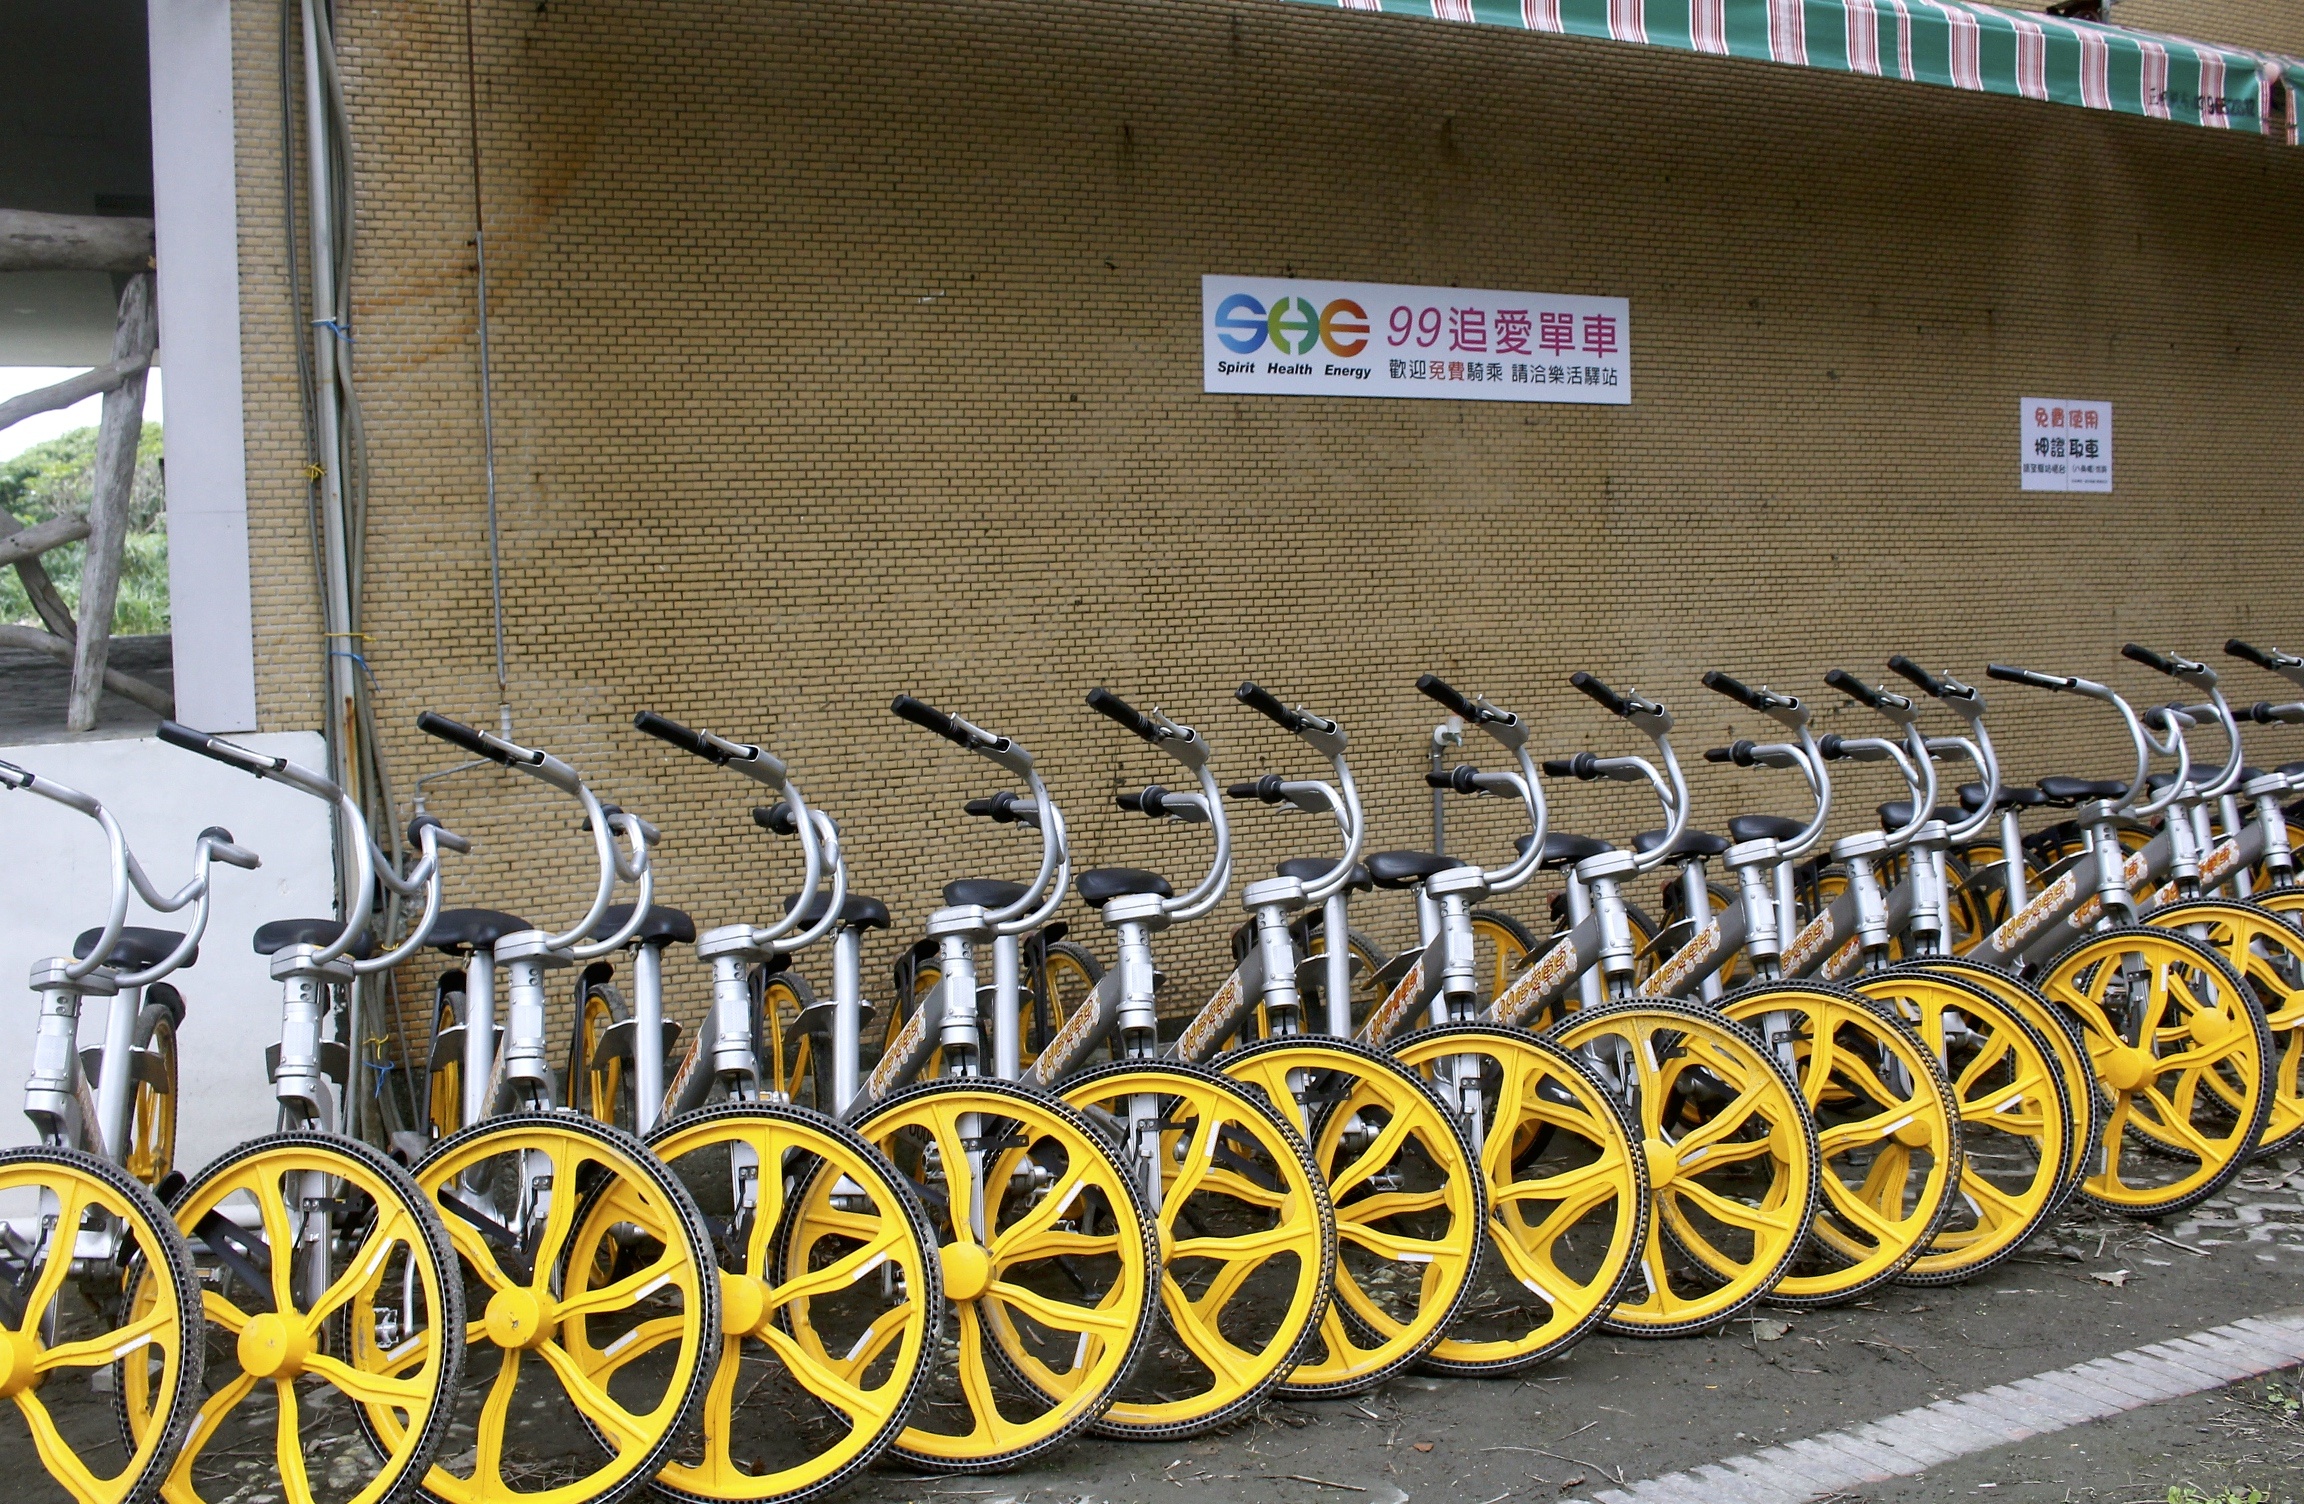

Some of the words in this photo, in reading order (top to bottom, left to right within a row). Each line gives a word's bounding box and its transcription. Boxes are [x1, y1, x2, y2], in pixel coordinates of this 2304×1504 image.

[1214, 293, 1370, 358] SHE
[1387, 305, 1618, 359] 99追愛單車
[1217, 360, 1256, 375] Spirit
[1267, 362, 1313, 376] Health
[1324, 363, 1372, 379] Energy
[1388, 358, 1503, 383] 歡迎免費騎乘
